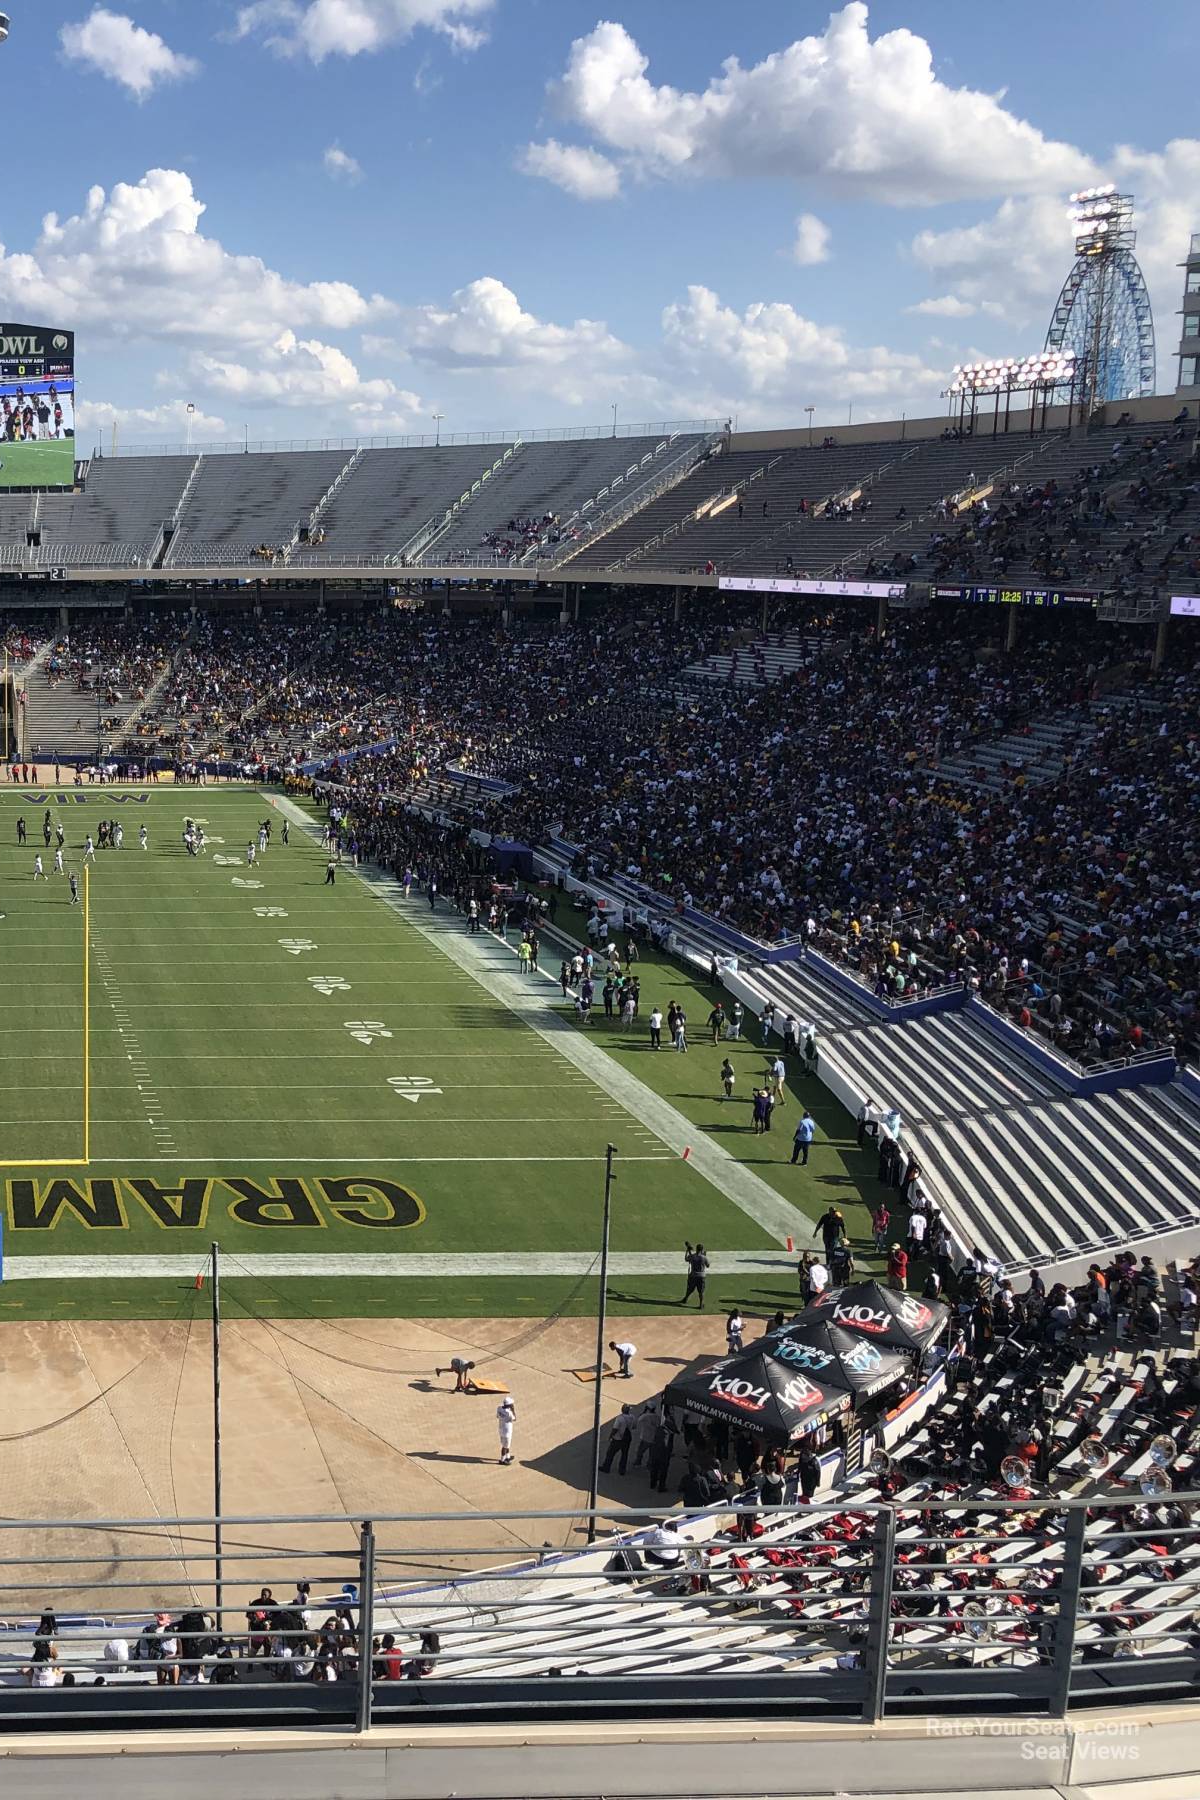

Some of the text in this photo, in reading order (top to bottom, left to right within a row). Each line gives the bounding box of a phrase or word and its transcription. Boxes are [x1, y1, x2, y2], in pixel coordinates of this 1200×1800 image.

[18, 365, 25, 375] 0
[1001, 591, 1022, 603] 12:25
[19, 793, 152, 806] VIEW
[386, 1076, 444, 1095] 10
[832, 1304, 892, 1329] K104
[773, 1344, 831, 1370] 105.7
[778, 1337, 816, 1356] Smooth
[709, 1375, 771, 1407] K104
[777, 1373, 819, 1410] K104
[686, 1398, 764, 1433] WWW.MYK104.COM
